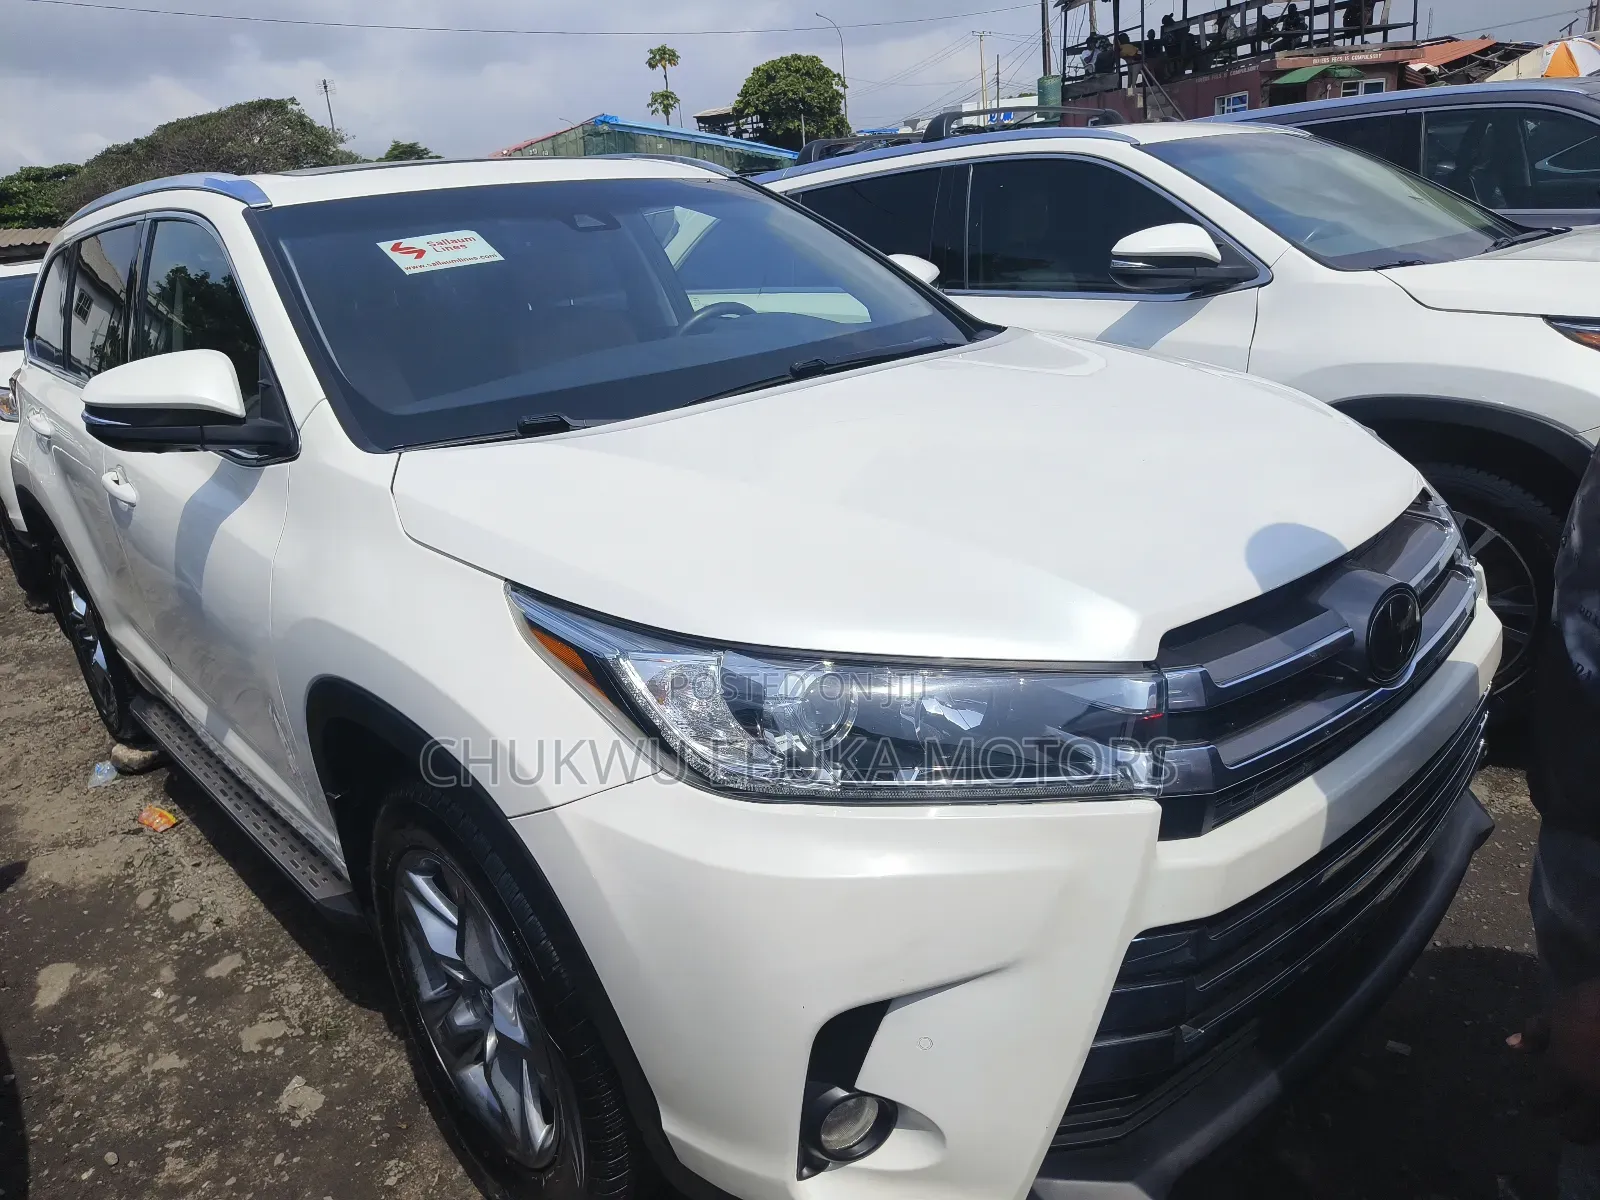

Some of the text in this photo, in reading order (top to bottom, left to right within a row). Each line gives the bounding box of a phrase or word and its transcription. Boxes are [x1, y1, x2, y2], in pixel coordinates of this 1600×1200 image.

[426, 236, 477, 247] Sallaum
[432, 244, 468, 253] Lines
[404, 253, 498, 271] www.sallaumlines.com
